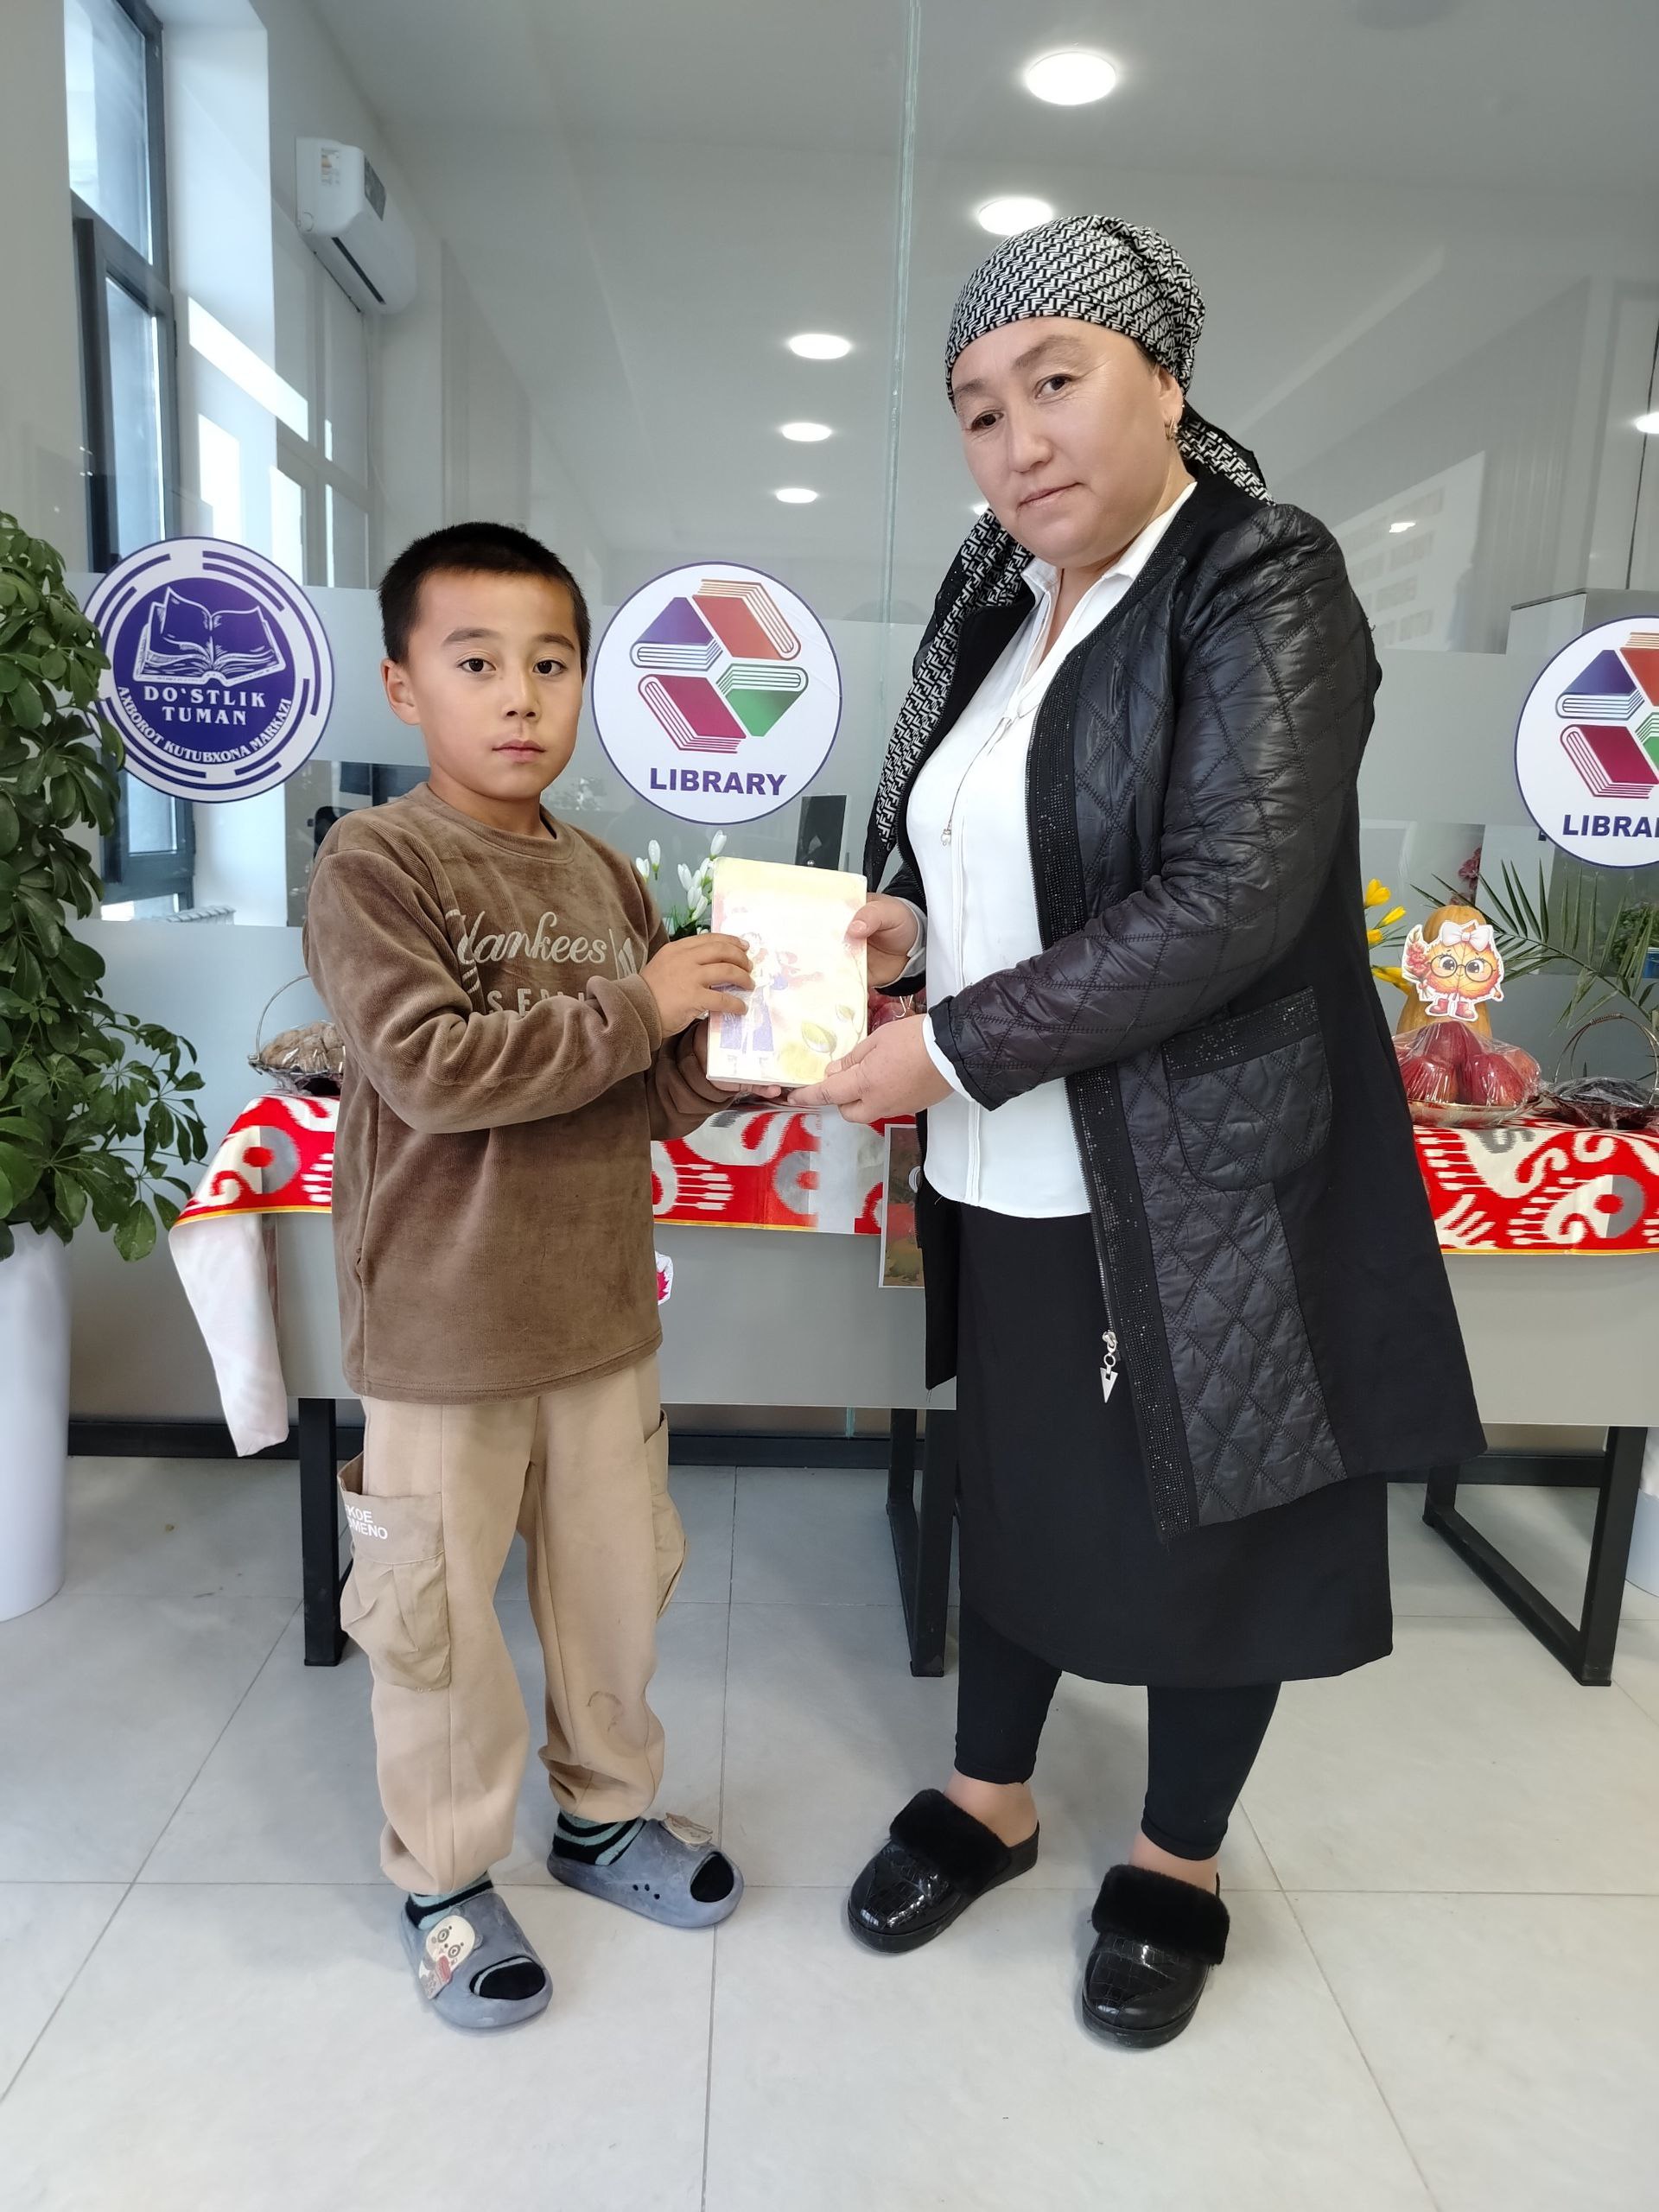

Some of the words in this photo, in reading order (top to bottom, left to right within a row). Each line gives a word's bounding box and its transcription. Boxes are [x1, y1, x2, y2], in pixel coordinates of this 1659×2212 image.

[117, 686, 165, 745] AXBOROT
[162, 741, 251, 764] KUTUBXONA
[249, 698, 293, 751] MARKAZI
[162, 706, 247, 726] TUMAN
[650, 767, 787, 796] LIBRARY
[1562, 814, 1659, 838] LIBRA
[345, 1504, 373, 1523] KOE
